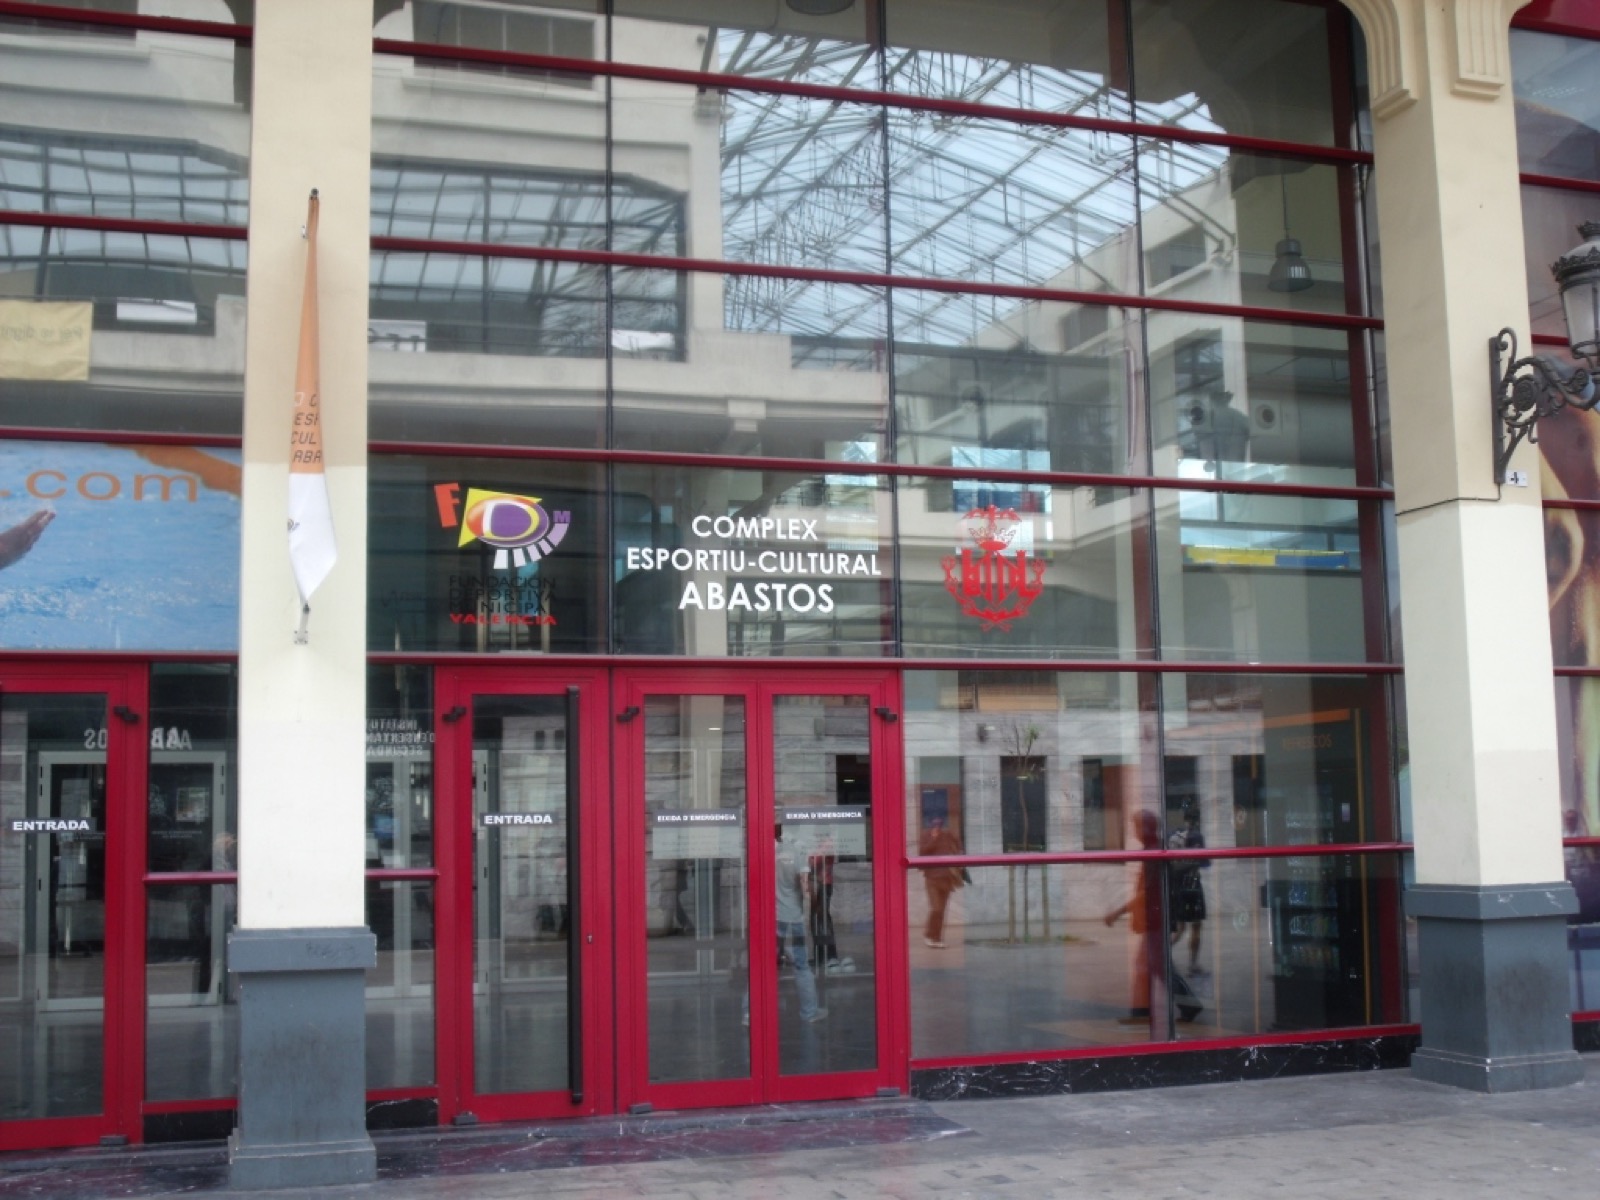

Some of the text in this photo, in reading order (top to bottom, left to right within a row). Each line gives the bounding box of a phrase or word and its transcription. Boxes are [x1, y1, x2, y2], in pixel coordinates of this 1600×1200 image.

[692, 515, 818, 541] COMPLEX
[627, 547, 882, 576] ESPORTIU-CULTURAL
[678, 581, 835, 613] ABASTOS
[12, 819, 90, 831] ENTRADA
[484, 814, 553, 825] ENTRADA
